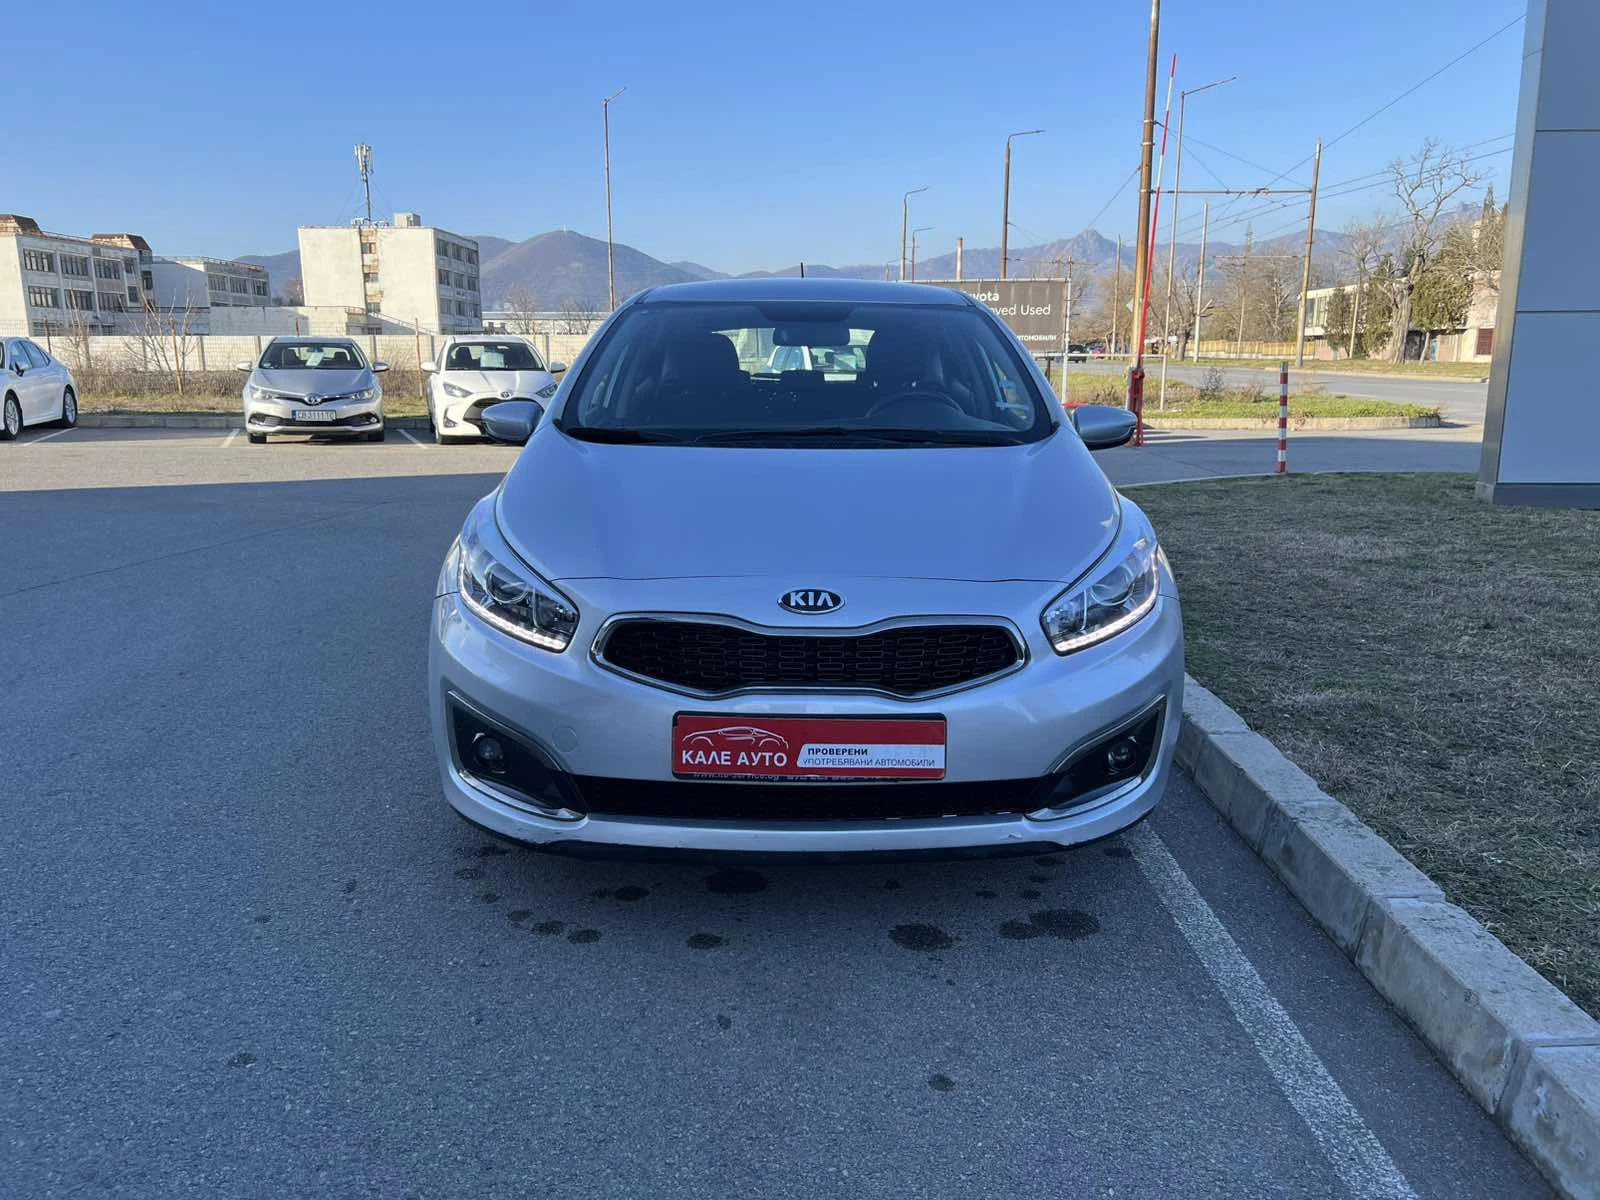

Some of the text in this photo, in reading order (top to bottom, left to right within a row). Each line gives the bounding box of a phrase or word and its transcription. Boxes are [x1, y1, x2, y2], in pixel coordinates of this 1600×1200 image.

[1020, 304, 1051, 315] Used
[790, 591, 834, 607] KIA
[807, 748, 868, 756] ПРОВЕРЕНИ
[682, 750, 788, 767] КАЛЕ АУТО
[803, 757, 936, 767] УПОТРЕБЯВАНИ АВТОМОБИЛИ
